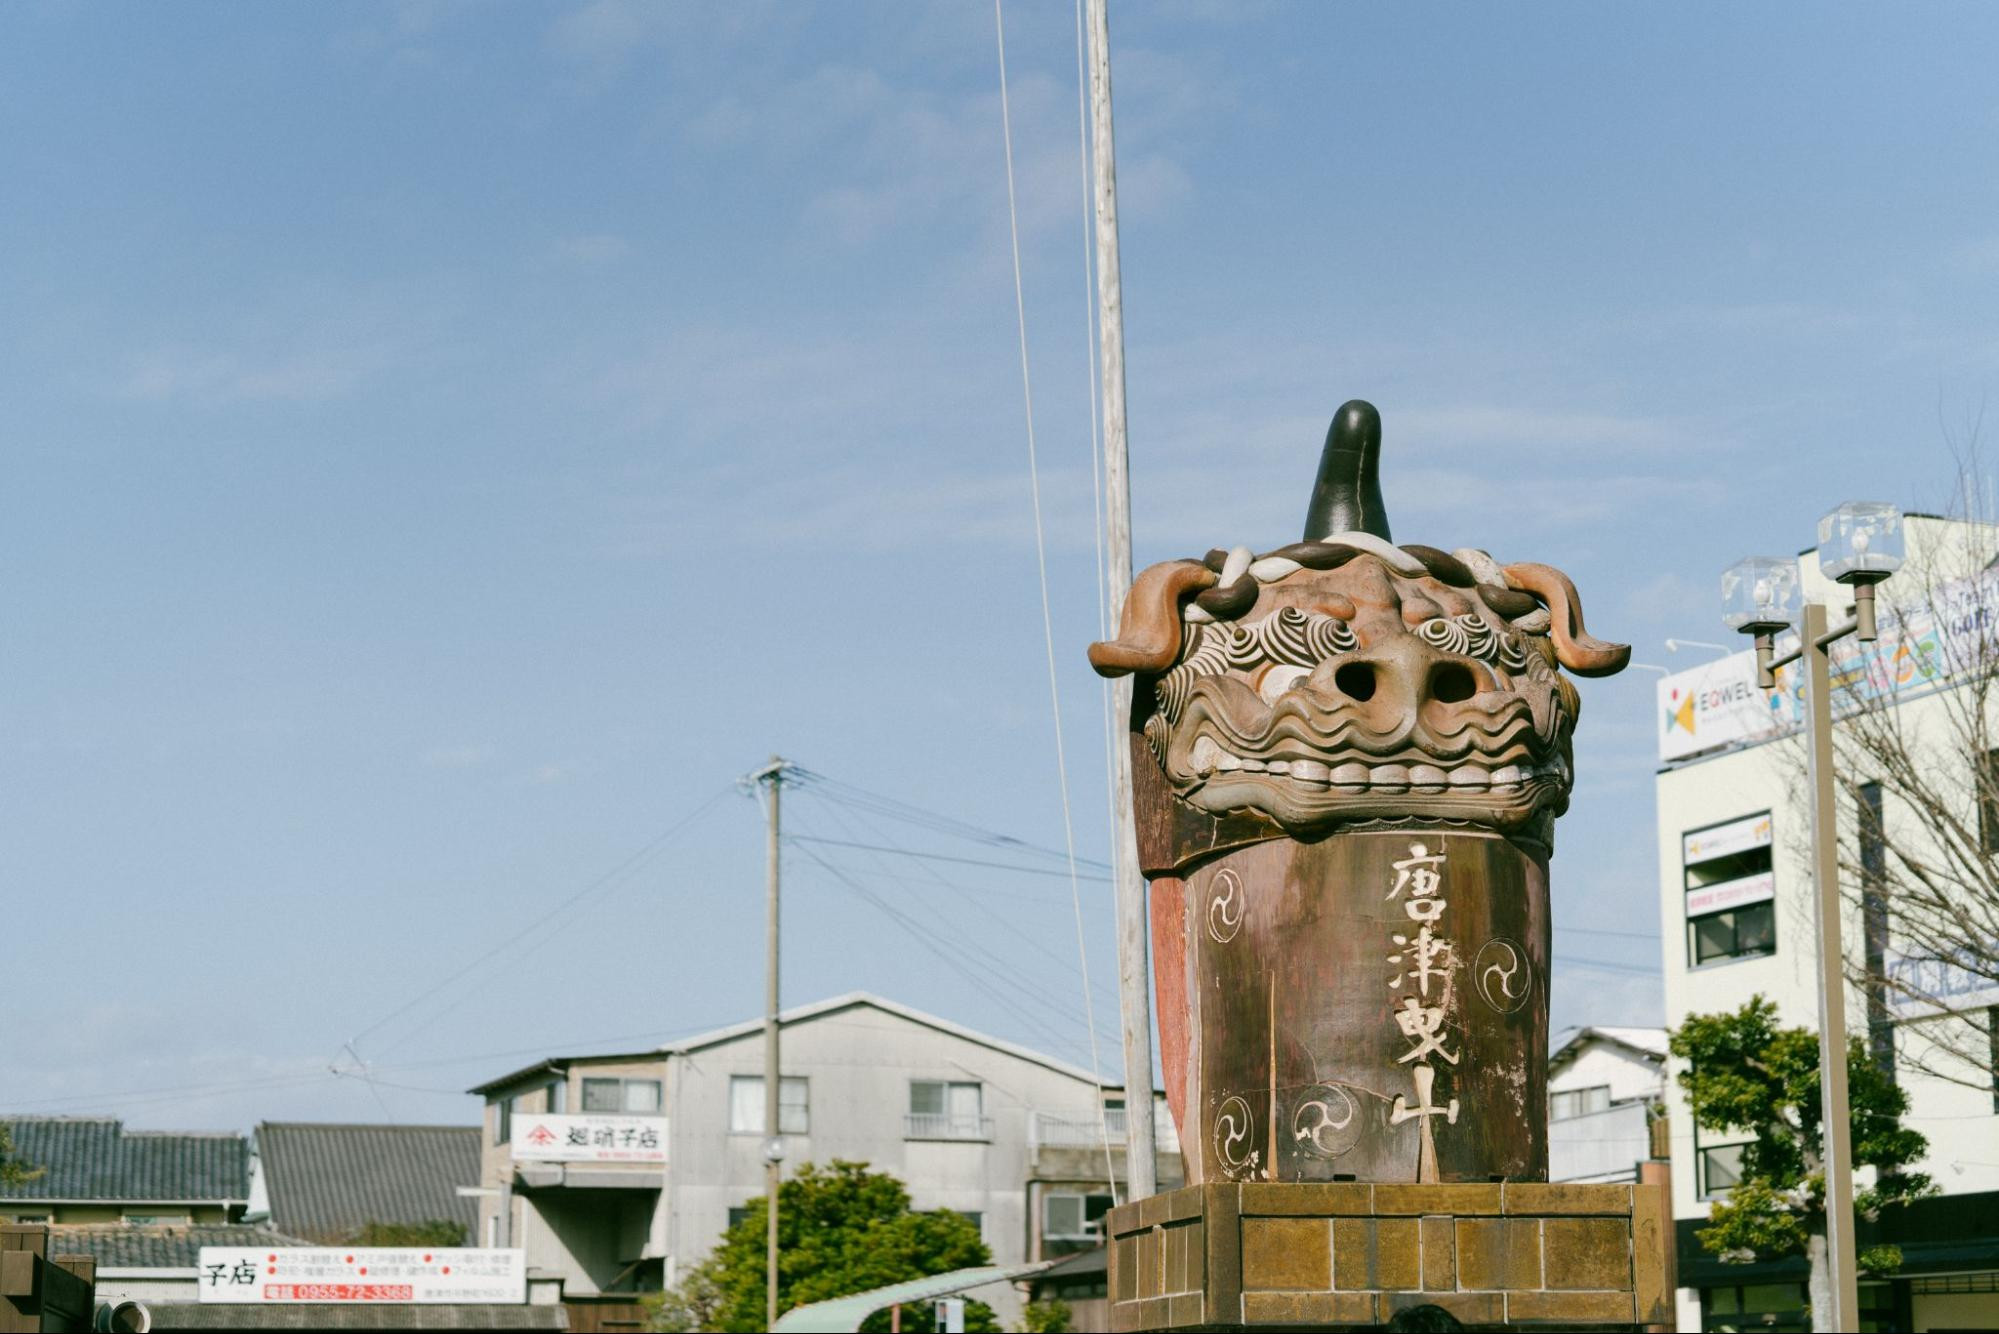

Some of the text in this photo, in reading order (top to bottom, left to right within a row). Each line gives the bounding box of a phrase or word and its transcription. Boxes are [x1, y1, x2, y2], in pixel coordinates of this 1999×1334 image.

[1385, 841, 1459, 1125] 唐津曳山
[201, 1259, 257, 1286] 子店
